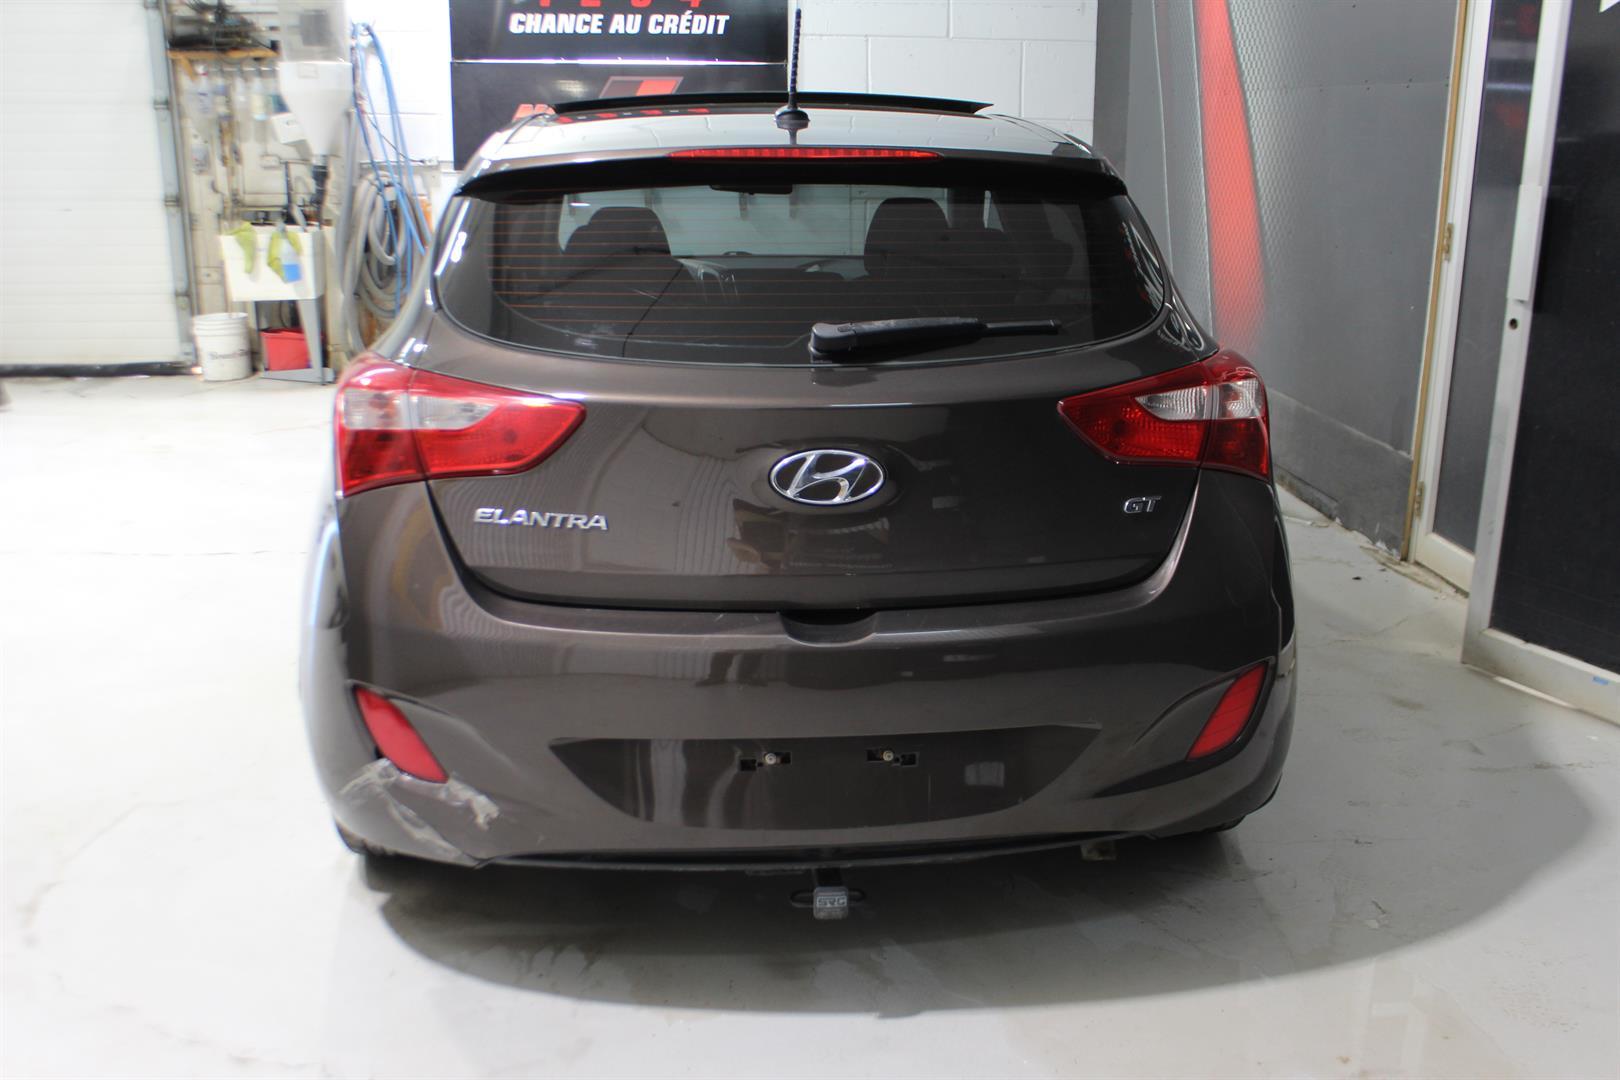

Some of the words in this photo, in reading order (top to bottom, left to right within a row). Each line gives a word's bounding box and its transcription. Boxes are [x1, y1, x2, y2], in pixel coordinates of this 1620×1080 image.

[509, 12, 604, 34] CHANCE
[608, 13, 642, 35] AU
[648, 9, 730, 35] CRÉDIT
[1123, 496, 1162, 514] GT
[473, 507, 609, 531] ELANTRA
